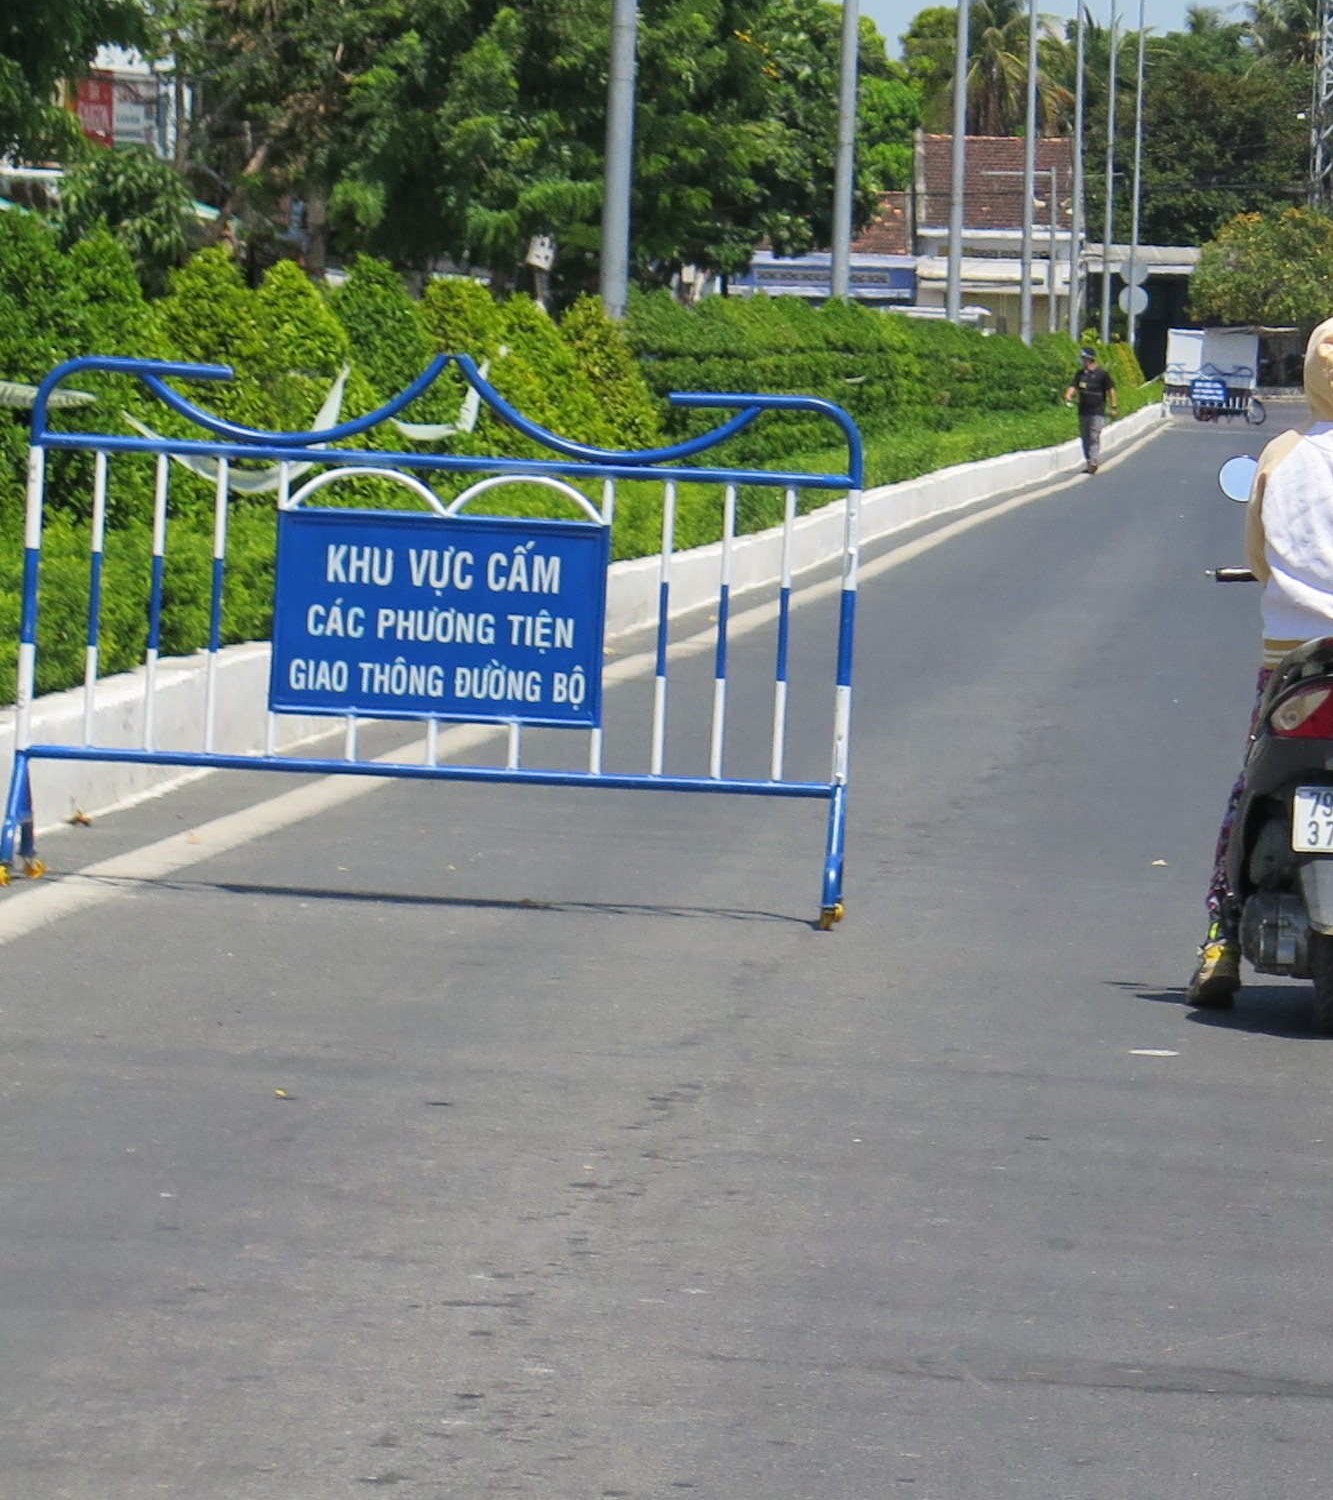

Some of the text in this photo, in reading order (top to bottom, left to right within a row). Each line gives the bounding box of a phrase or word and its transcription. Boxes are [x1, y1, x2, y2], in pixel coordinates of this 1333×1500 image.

[326, 541, 561, 597] KHU VỰC CẤM
[306, 598, 575, 654] CÁC PHƯƠNG TIỆN
[288, 657, 587, 710] GIAO THÔNG ĐƯỜNG BỘ
